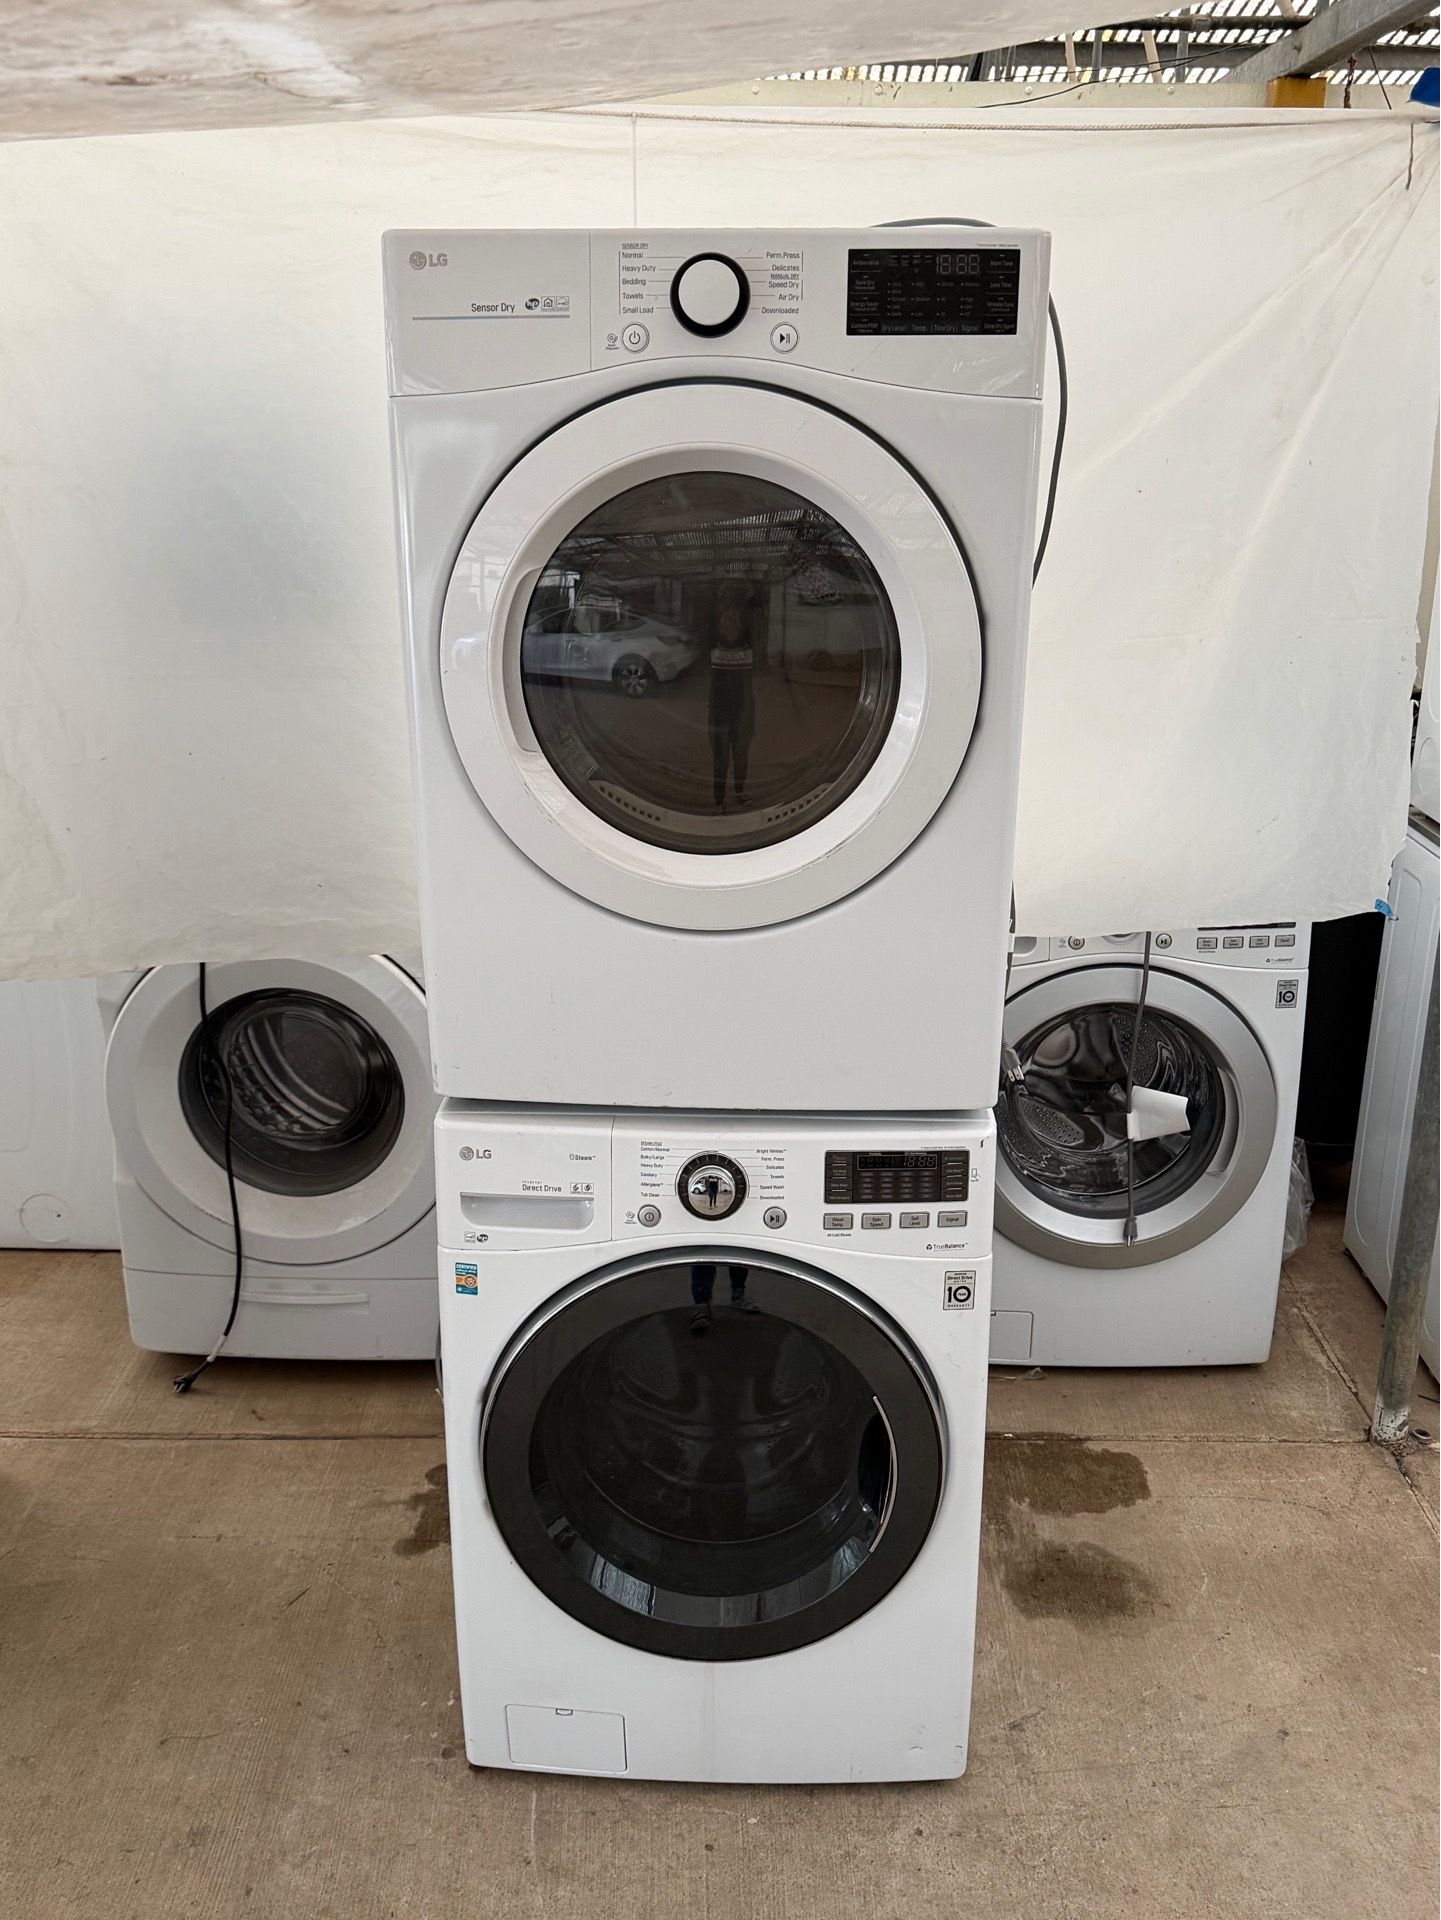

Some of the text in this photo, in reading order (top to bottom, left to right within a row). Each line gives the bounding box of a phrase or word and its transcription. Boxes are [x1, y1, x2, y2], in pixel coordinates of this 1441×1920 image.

[428, 253, 448, 267] LG
[772, 264, 800, 272] Delicates
[768, 281, 799, 289] Speed Dry
[788, 293, 799, 301] Dry
[471, 303, 516, 314] Sensor Dry
[640, 306, 654, 314] Load
[475, 1149, 492, 1160] LG
[522, 1184, 562, 1193] Direct Drive
[947, 1286, 972, 1303] 10
